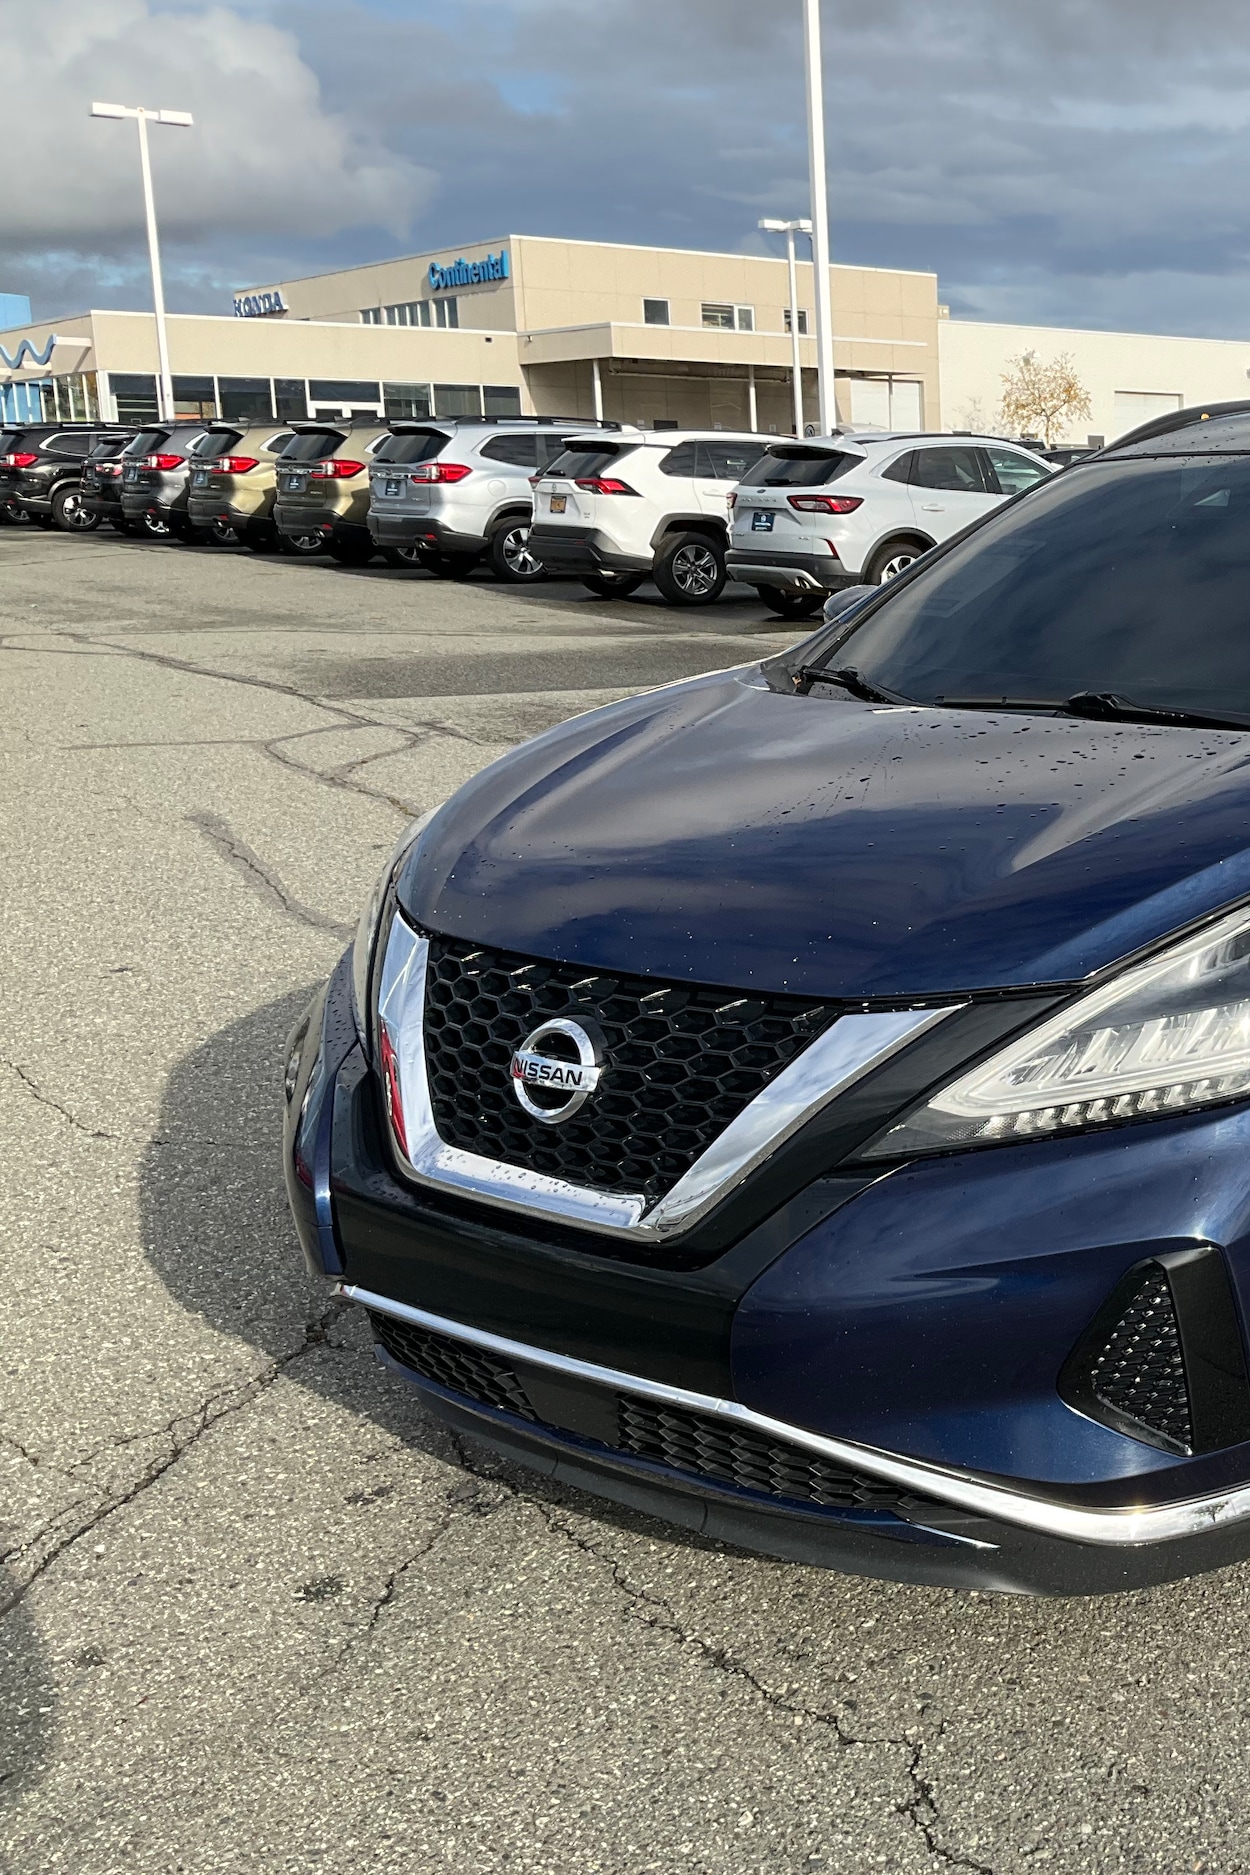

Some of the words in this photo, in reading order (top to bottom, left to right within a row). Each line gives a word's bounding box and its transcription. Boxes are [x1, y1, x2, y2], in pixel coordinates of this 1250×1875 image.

[428, 250, 509, 290] Continental
[233, 291, 285, 317] HONDA
[514, 1057, 583, 1086] NISSAN
